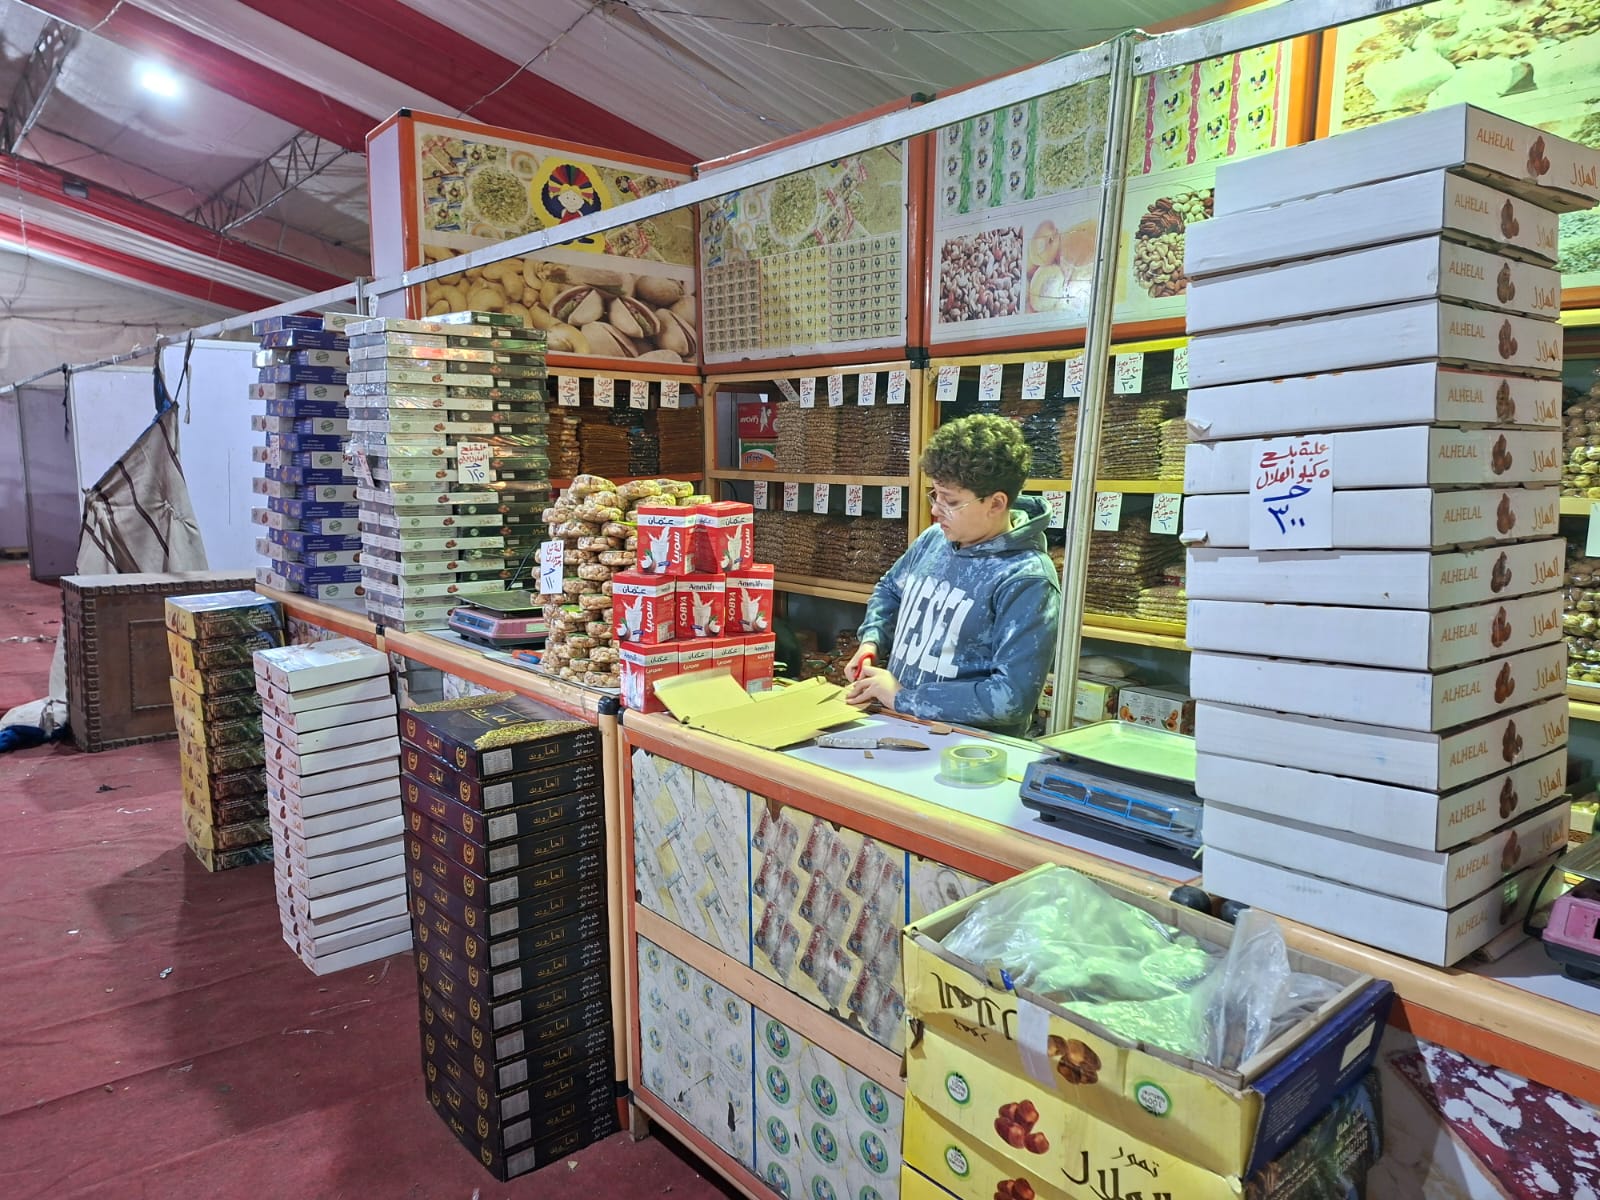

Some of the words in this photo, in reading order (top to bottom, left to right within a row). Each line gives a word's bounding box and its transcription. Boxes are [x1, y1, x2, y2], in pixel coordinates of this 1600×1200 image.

[1476, 129, 1516, 153] ALHELAL
[1454, 192, 1489, 216] ALHELAL
[1448, 259, 1485, 282] ALHELAL
[1449, 320, 1486, 339] ALHELAL
[1447, 388, 1484, 404] ALHELAL
[1438, 444, 1478, 459] ALHELAL
[1268, 504, 1305, 534] ٣٠٠
[1443, 507, 1483, 523] ALHELAL
[1441, 569, 1479, 584] ALHELAL
[680, 596, 688, 627] SOBYA
[1441, 621, 1479, 643] ALHELAL
[1442, 682, 1482, 704] ALHELAL
[1449, 739, 1489, 766] ALHELAL
[1448, 800, 1487, 827] ALHELAL
[1454, 852, 1490, 881] ALHELAL
[1112, 1147, 1160, 1177] تمور
